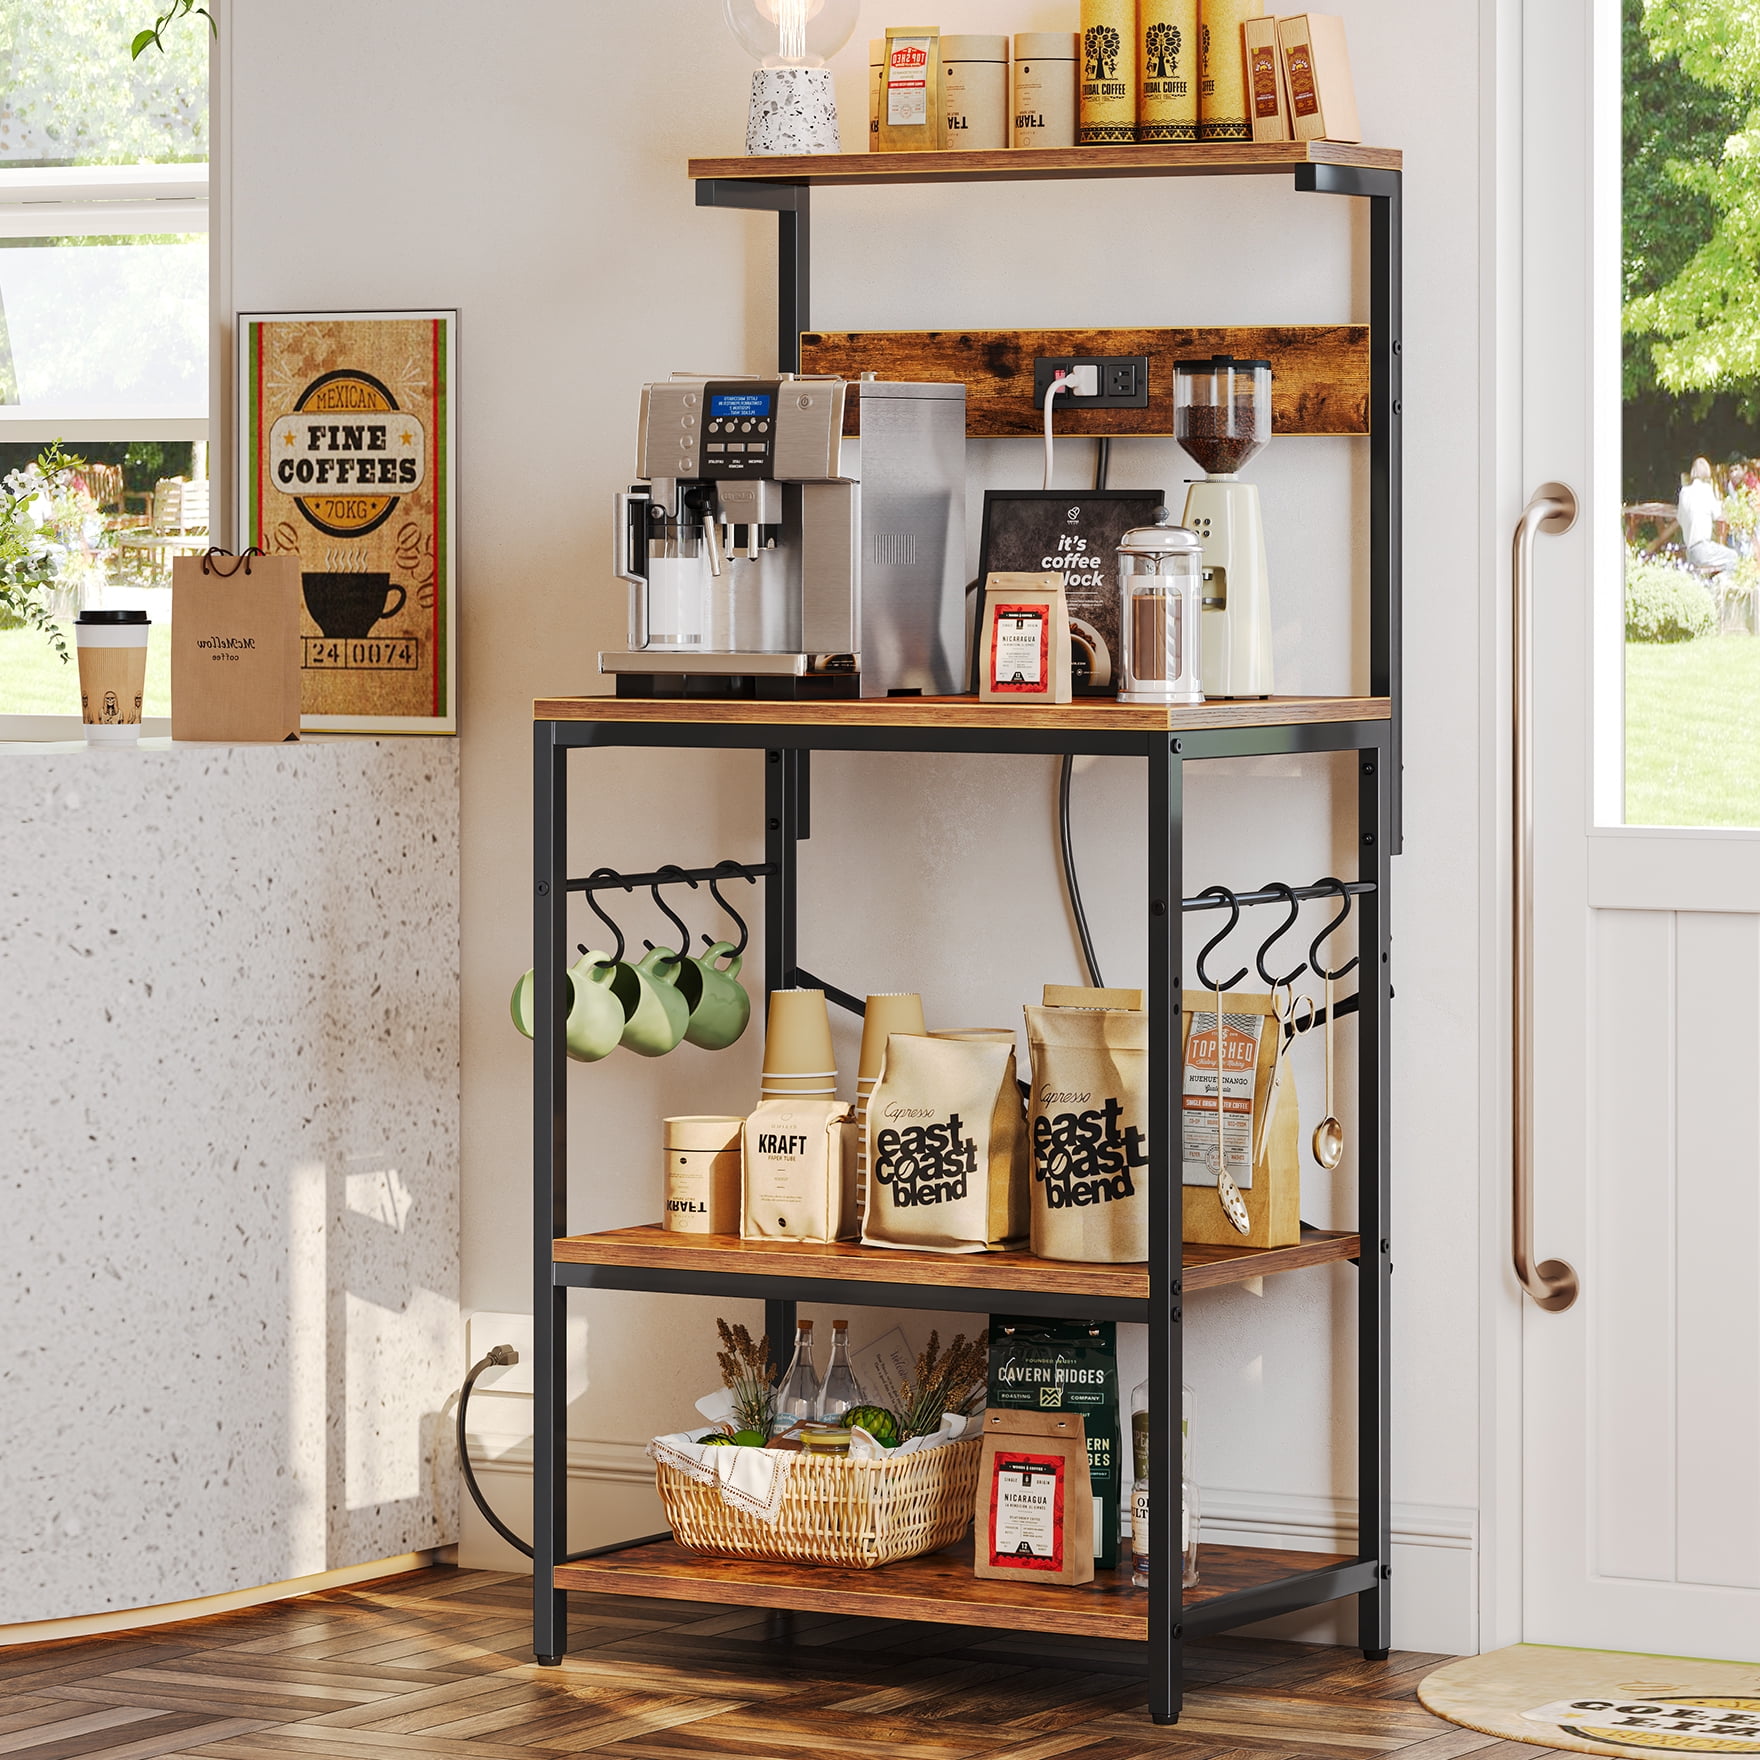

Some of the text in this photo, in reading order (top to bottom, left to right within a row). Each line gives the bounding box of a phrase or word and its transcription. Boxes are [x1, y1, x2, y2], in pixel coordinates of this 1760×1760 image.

[1101, 84, 1126, 95] COFFEE
[1162, 82, 1188, 93] COFFEE
[316, 386, 377, 410] MEXICAN
[307, 425, 387, 451] FINE
[277, 458, 417, 485] COFFEES
[325, 500, 367, 521] 70KG
[1041, 553, 1101, 568] coffee
[312, 643, 412, 665] 24 0074
[1192, 1040, 1253, 1062] TOP SHED
[1040, 1083, 1091, 1109] Capresso
[883, 1101, 935, 1123] Capresso
[1033, 1097, 1124, 1149] east
[758, 1134, 807, 1155] KRAFT
[877, 1113, 964, 1156] east
[875, 1137, 978, 1185] coast
[1034, 1126, 1149, 1182] coast
[892, 1171, 967, 1208] blend
[1045, 1165, 1135, 1209] blend
[998, 1367, 1104, 1384] CAVERN RIDGES
[1004, 1493, 1047, 1504] NICARAGUA
